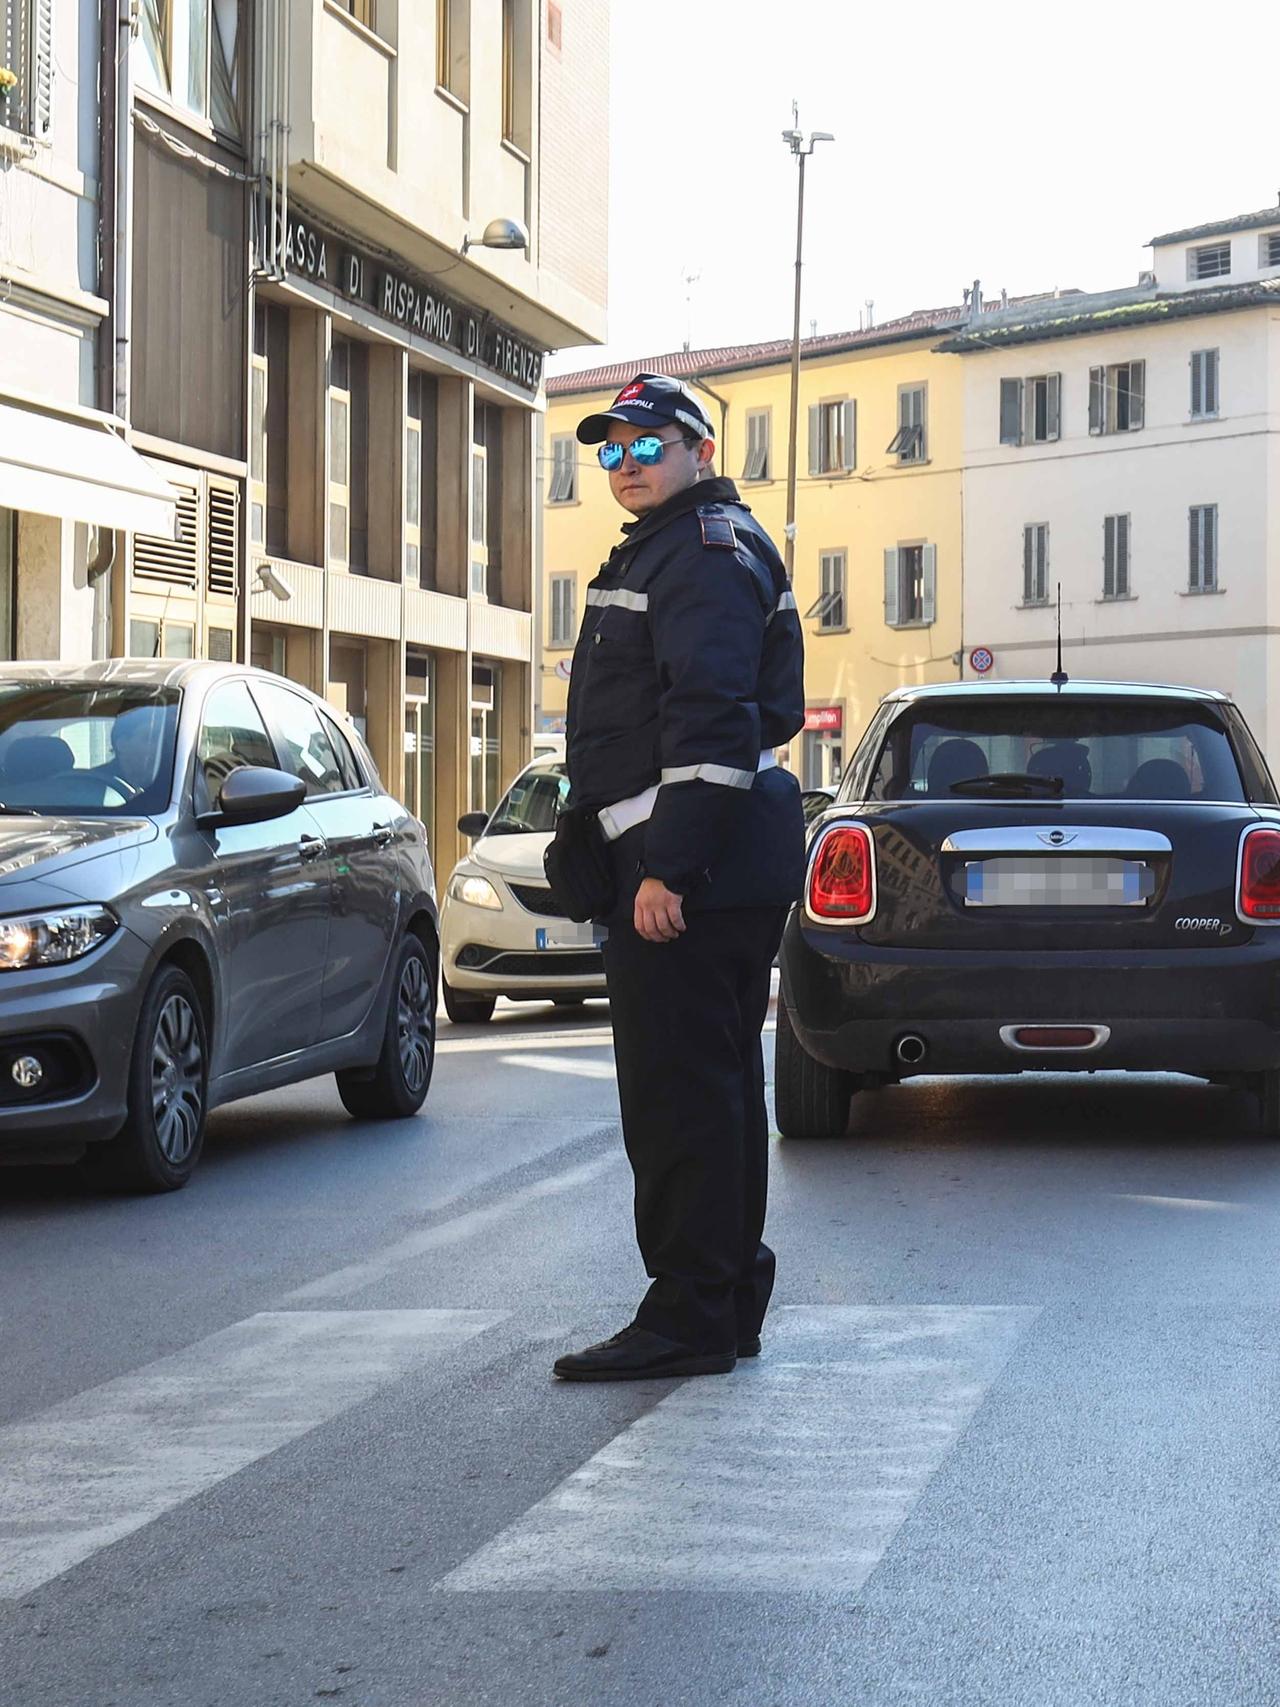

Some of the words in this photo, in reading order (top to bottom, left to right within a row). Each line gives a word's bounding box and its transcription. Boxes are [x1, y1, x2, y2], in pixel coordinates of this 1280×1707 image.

[349, 254, 364, 299] DI
[384, 273, 453, 342] RISPARMIO
[467, 319, 480, 357] DI
[495, 333, 539, 387] FIRENZE
[1174, 917, 1220, 931] COOPER
[1219, 923, 1233, 937] D
